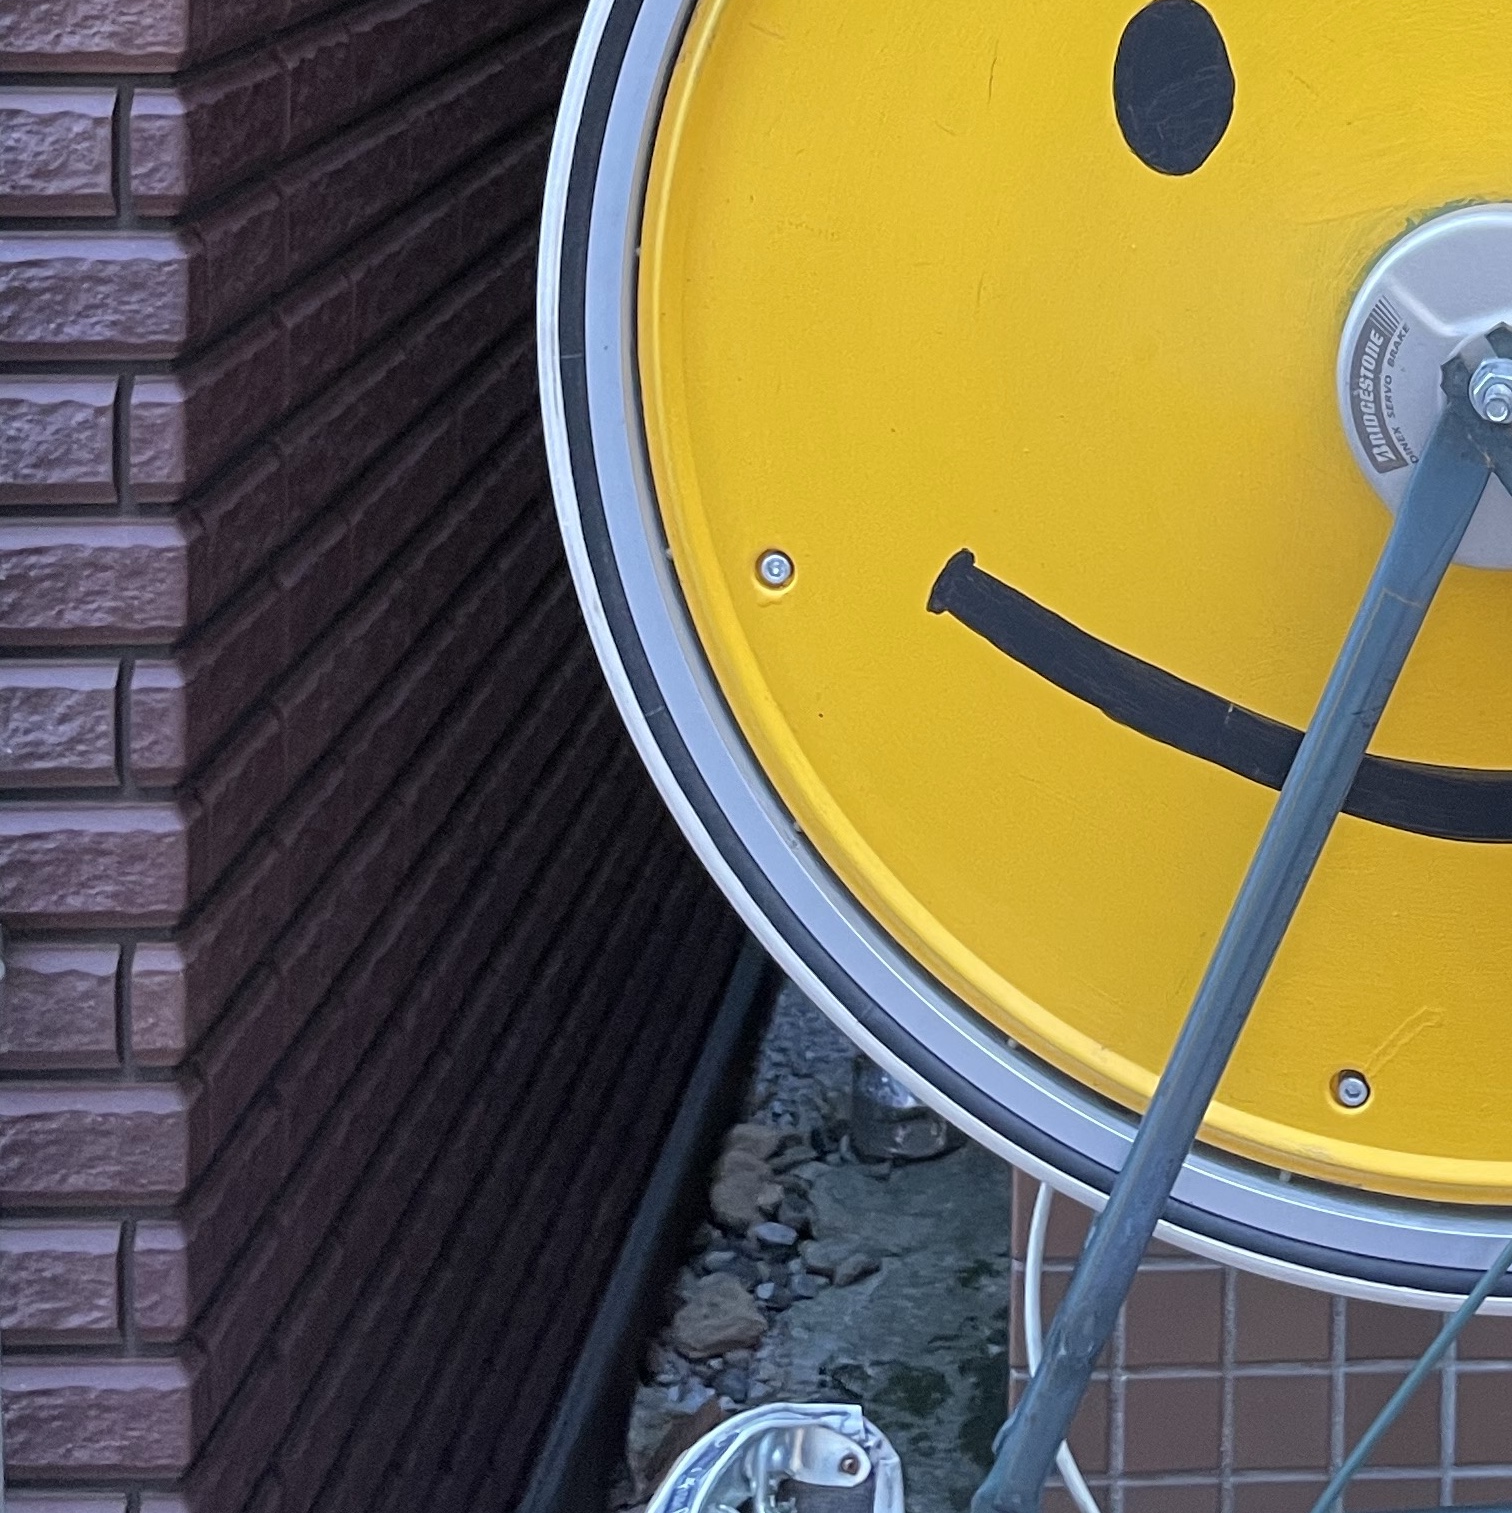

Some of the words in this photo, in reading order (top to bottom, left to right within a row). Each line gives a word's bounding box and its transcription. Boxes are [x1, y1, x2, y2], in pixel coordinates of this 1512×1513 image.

[1387, 322, 1410, 367] BRAKE
[1359, 329, 1396, 462] BRIDGESTONE
[1384, 375, 1395, 418] SERVO
